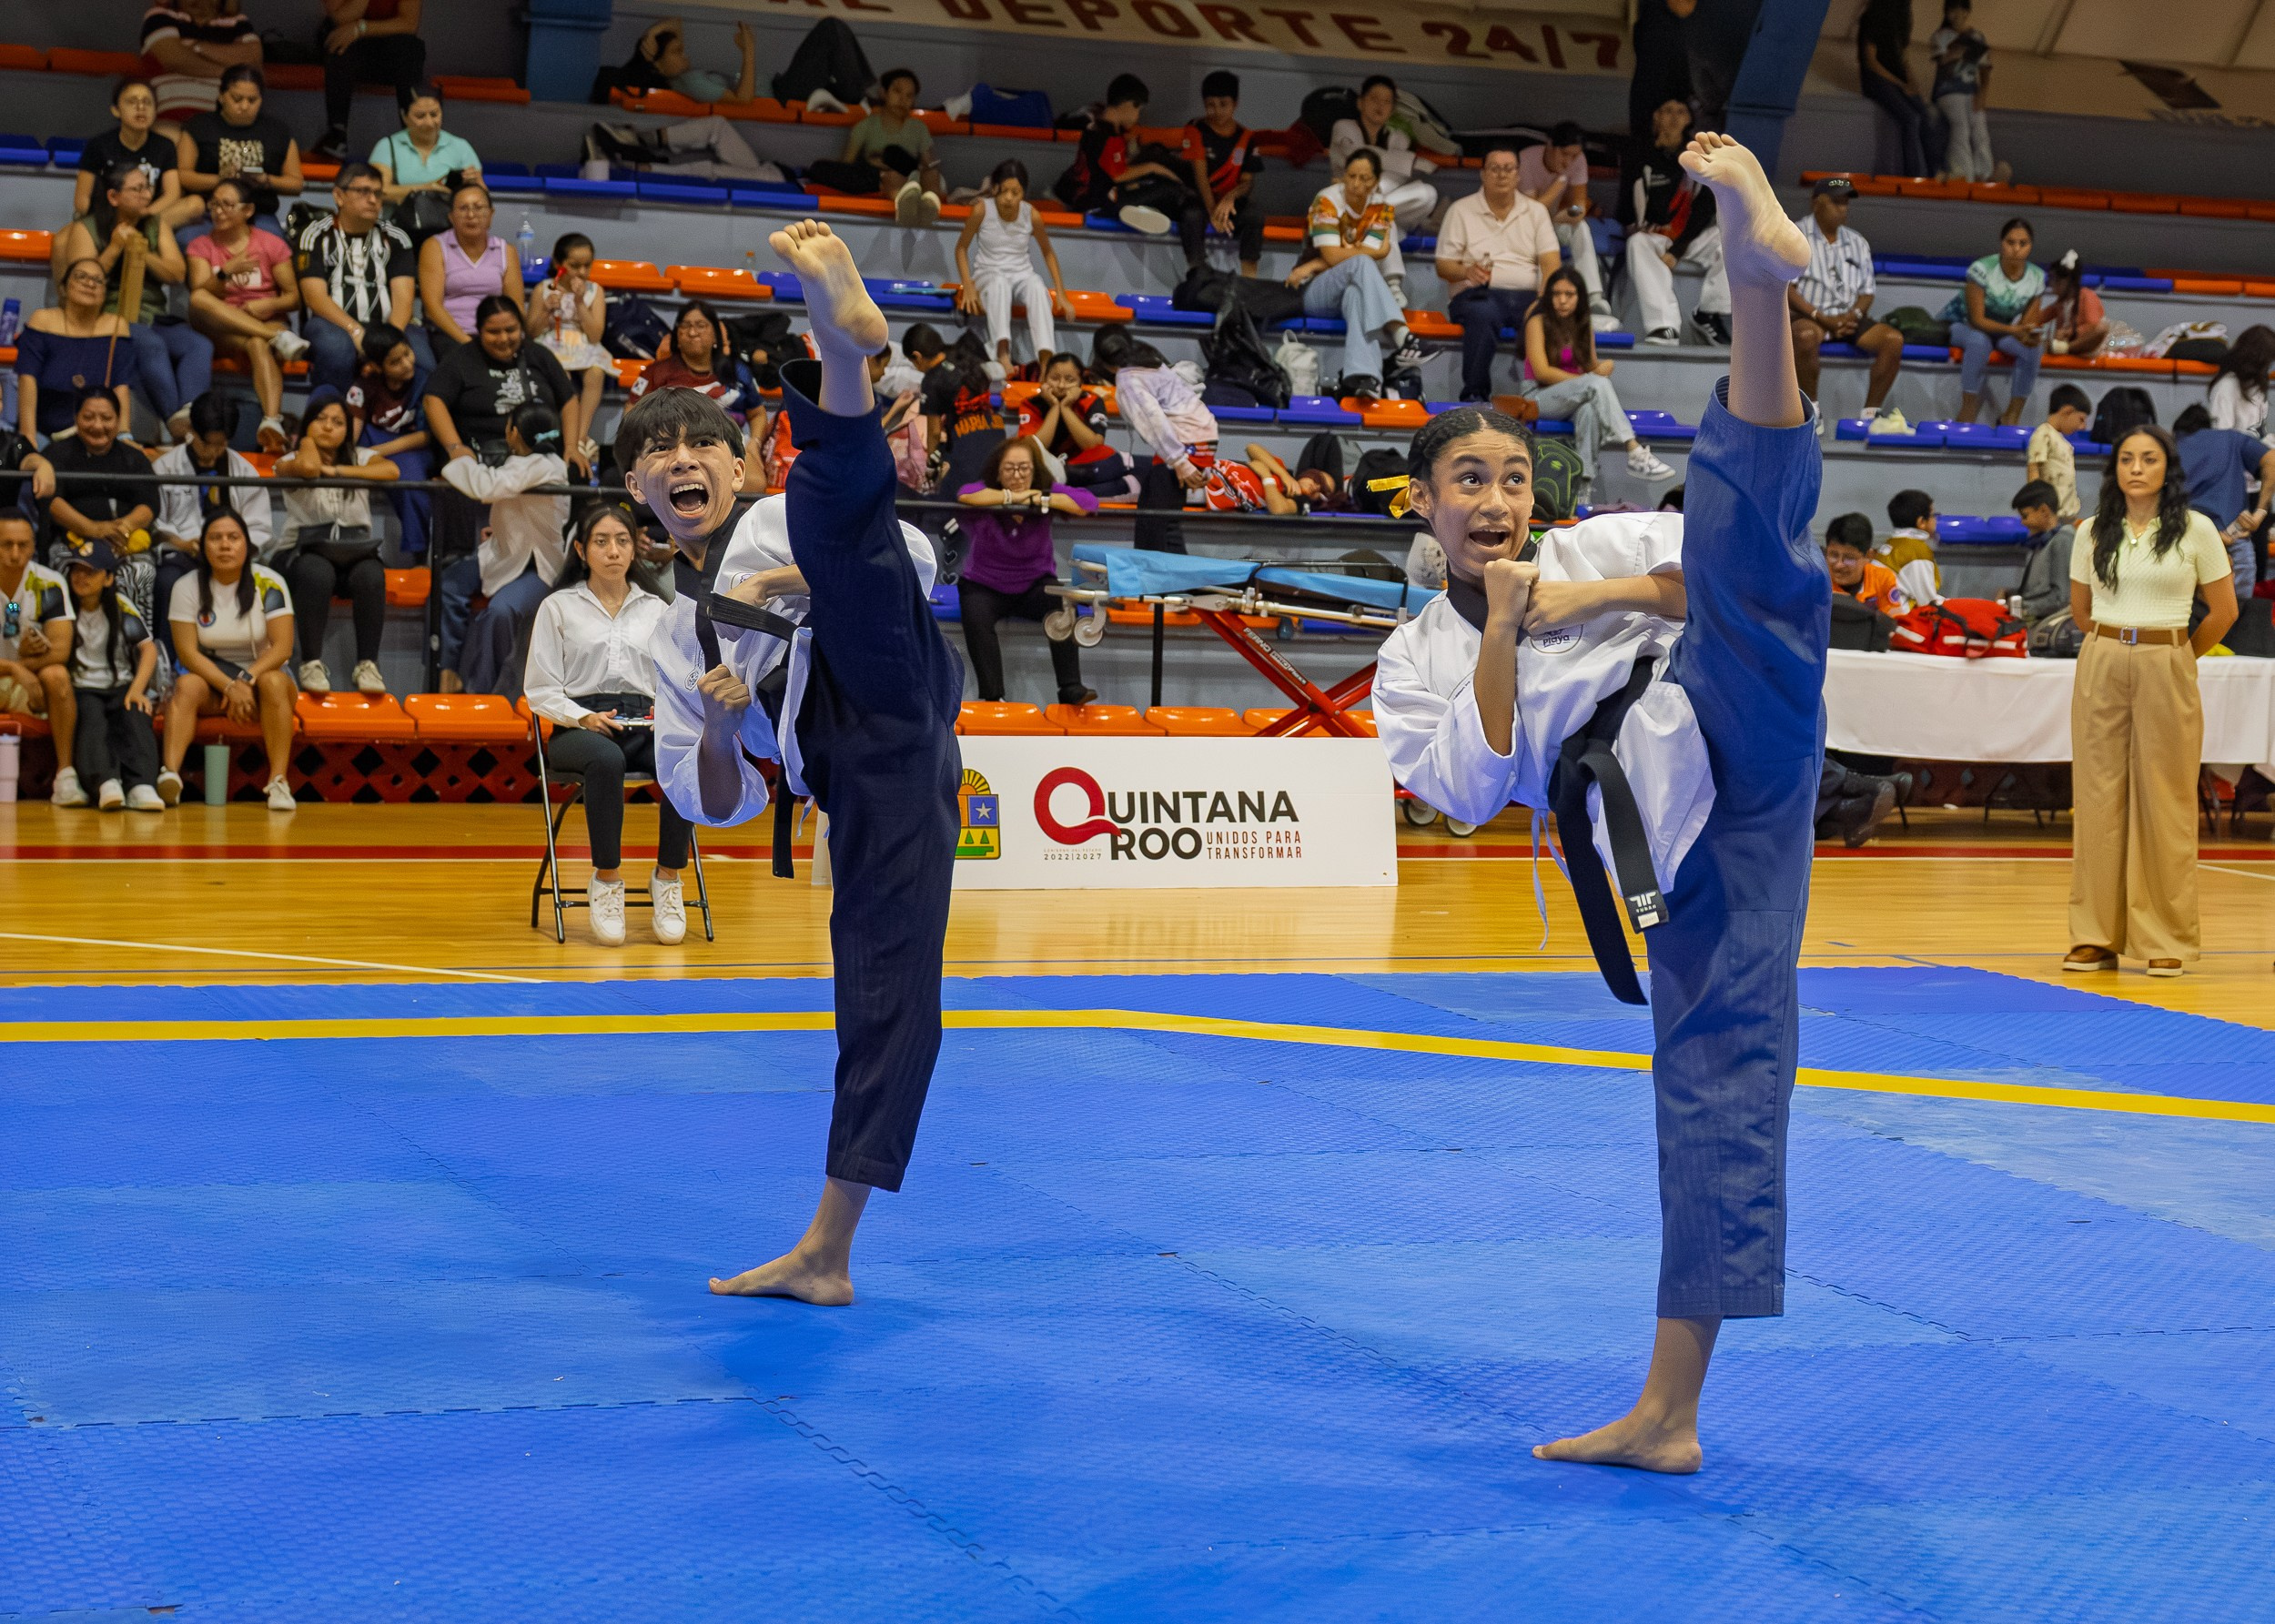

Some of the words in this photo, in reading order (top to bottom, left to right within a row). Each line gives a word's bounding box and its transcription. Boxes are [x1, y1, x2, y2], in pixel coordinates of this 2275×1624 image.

[937, 0, 1407, 53] DEPORTE
[1421, 20, 1623, 70] 24/7
[1034, 766, 1300, 845] QUINTANA
[1110, 827, 1203, 861] ROO
[1206, 831, 1259, 845] UNIDOS
[1265, 830, 1302, 844] PARA
[1206, 846, 1303, 860] TRANSFORMAR
